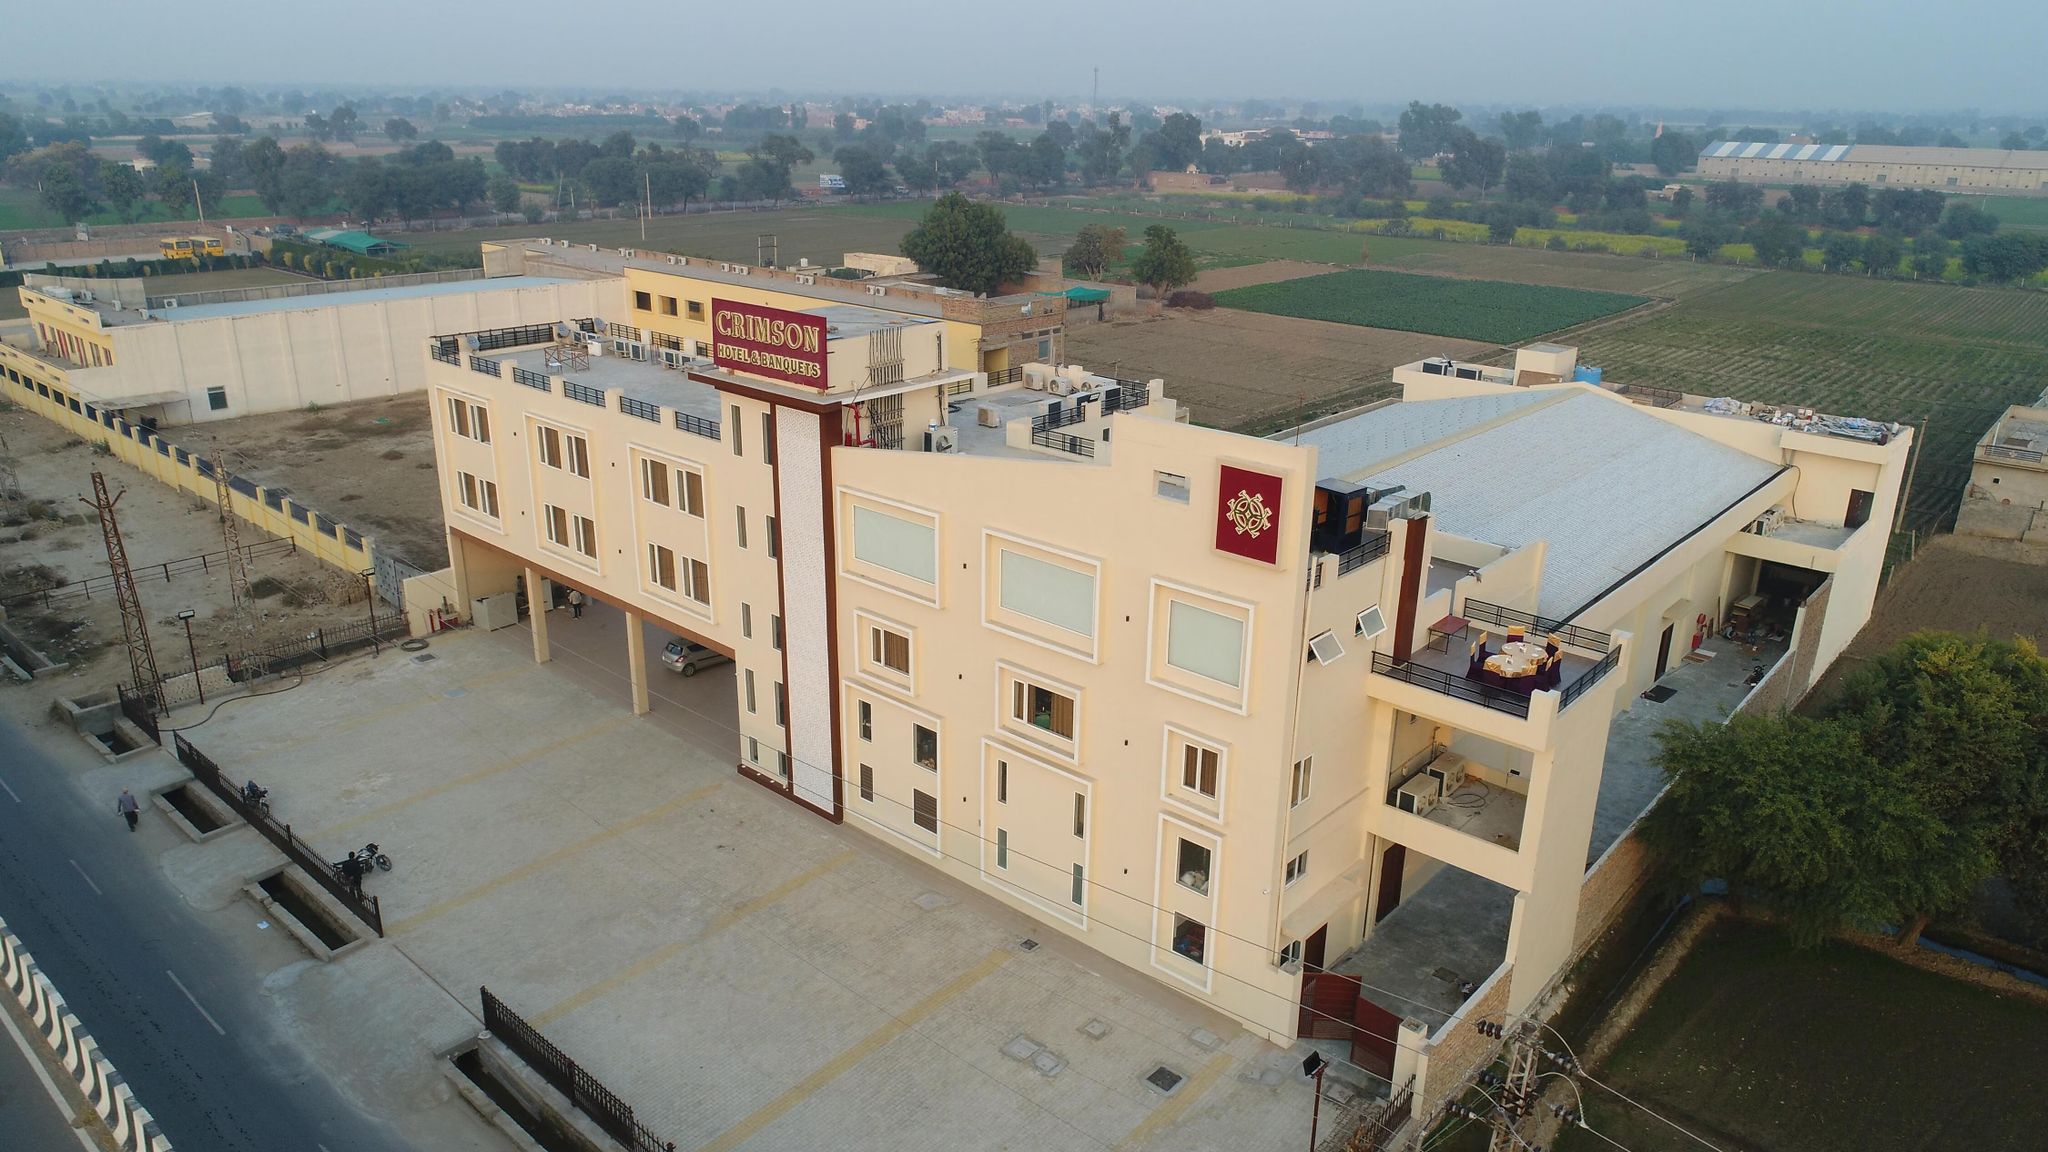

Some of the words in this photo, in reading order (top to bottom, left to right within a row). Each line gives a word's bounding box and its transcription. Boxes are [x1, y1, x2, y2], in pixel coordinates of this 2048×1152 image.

[716, 311, 819, 353] CRIMSON
[717, 343, 750, 363] HOTEL
[751, 350, 760, 366] &
[761, 352, 820, 377] BANQUETS
